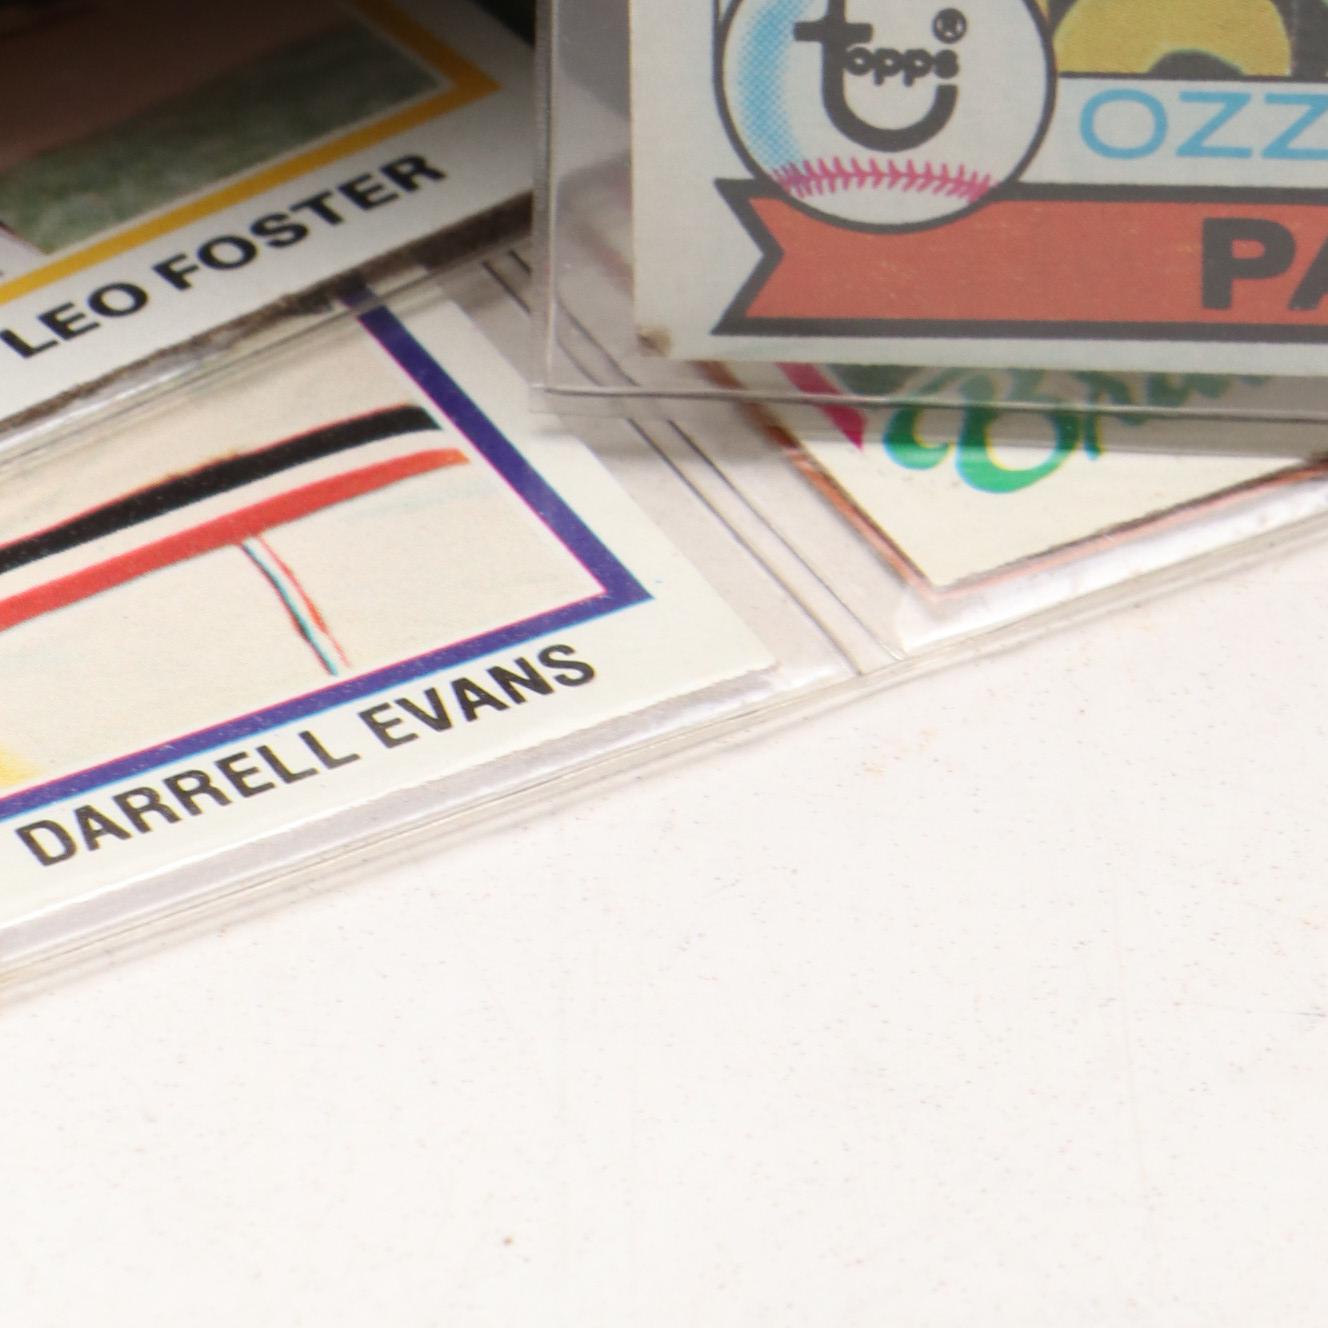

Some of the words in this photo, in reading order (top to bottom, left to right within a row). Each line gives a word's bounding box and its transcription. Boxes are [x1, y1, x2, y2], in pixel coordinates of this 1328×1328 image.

[0, 281, 148, 358] LEO
[152, 153, 447, 291] FOSTER
[15, 730, 360, 867] DARRELL
[357, 643, 596, 749] EVANS
